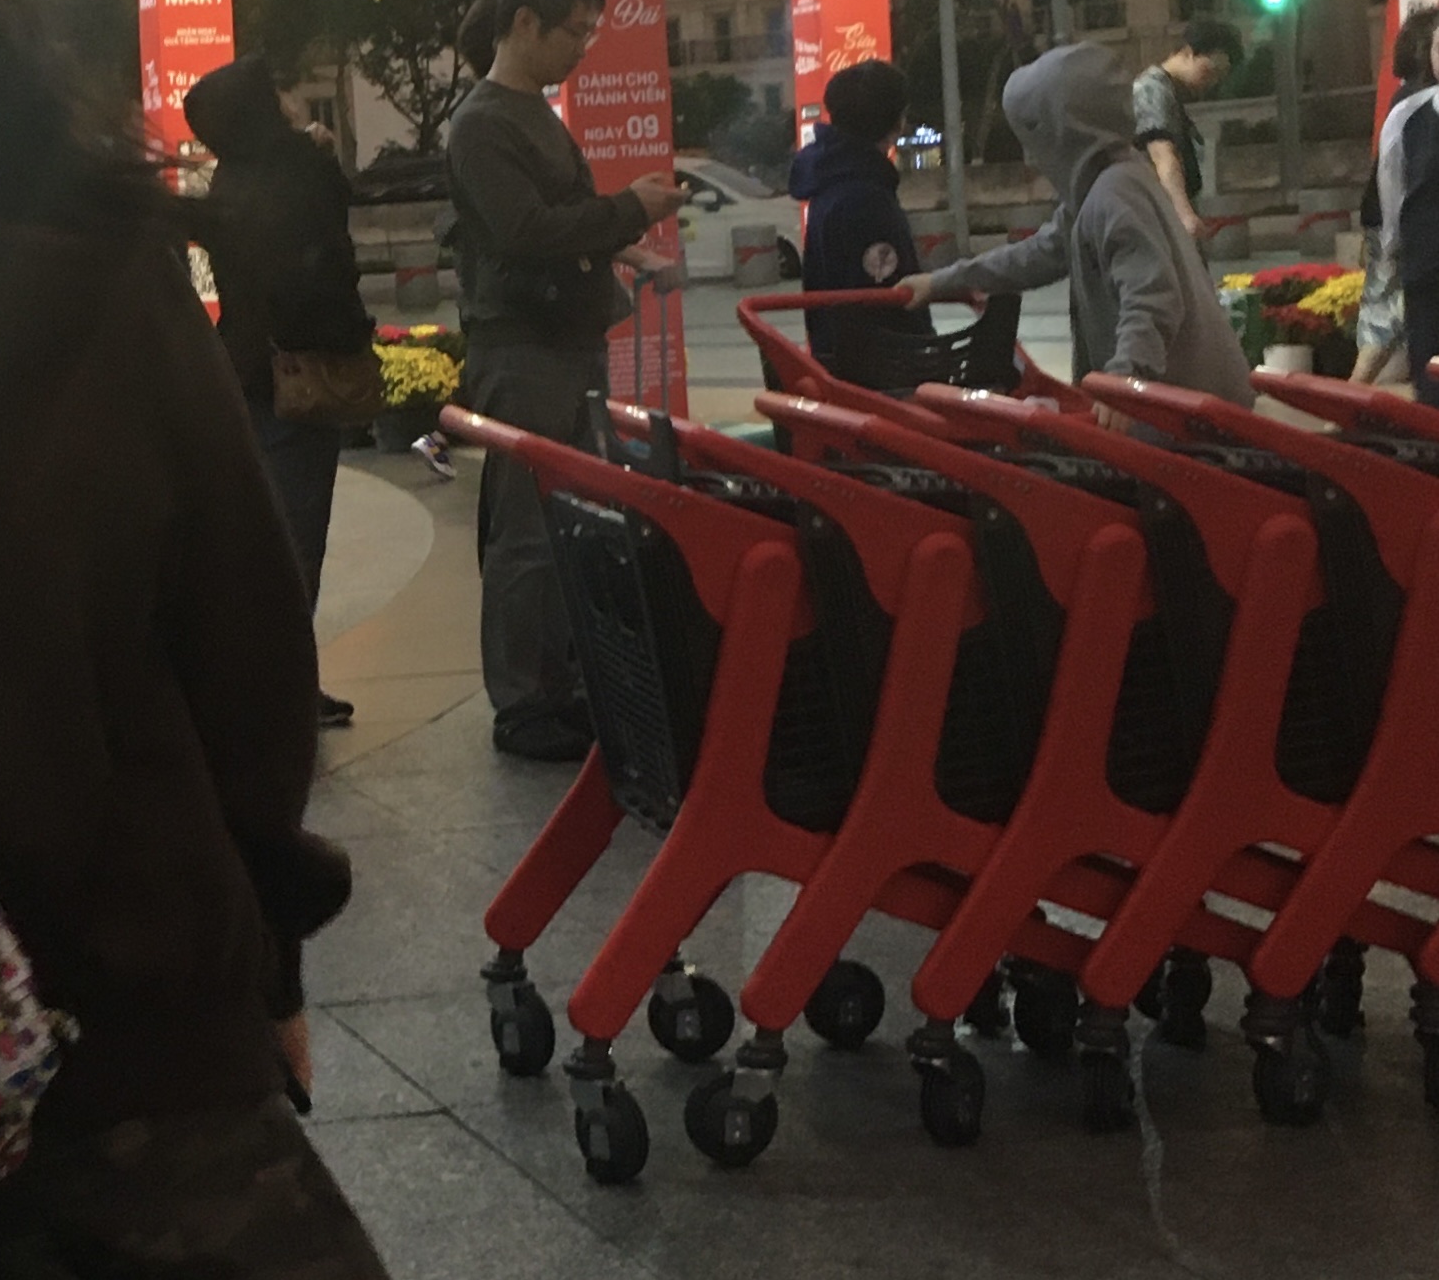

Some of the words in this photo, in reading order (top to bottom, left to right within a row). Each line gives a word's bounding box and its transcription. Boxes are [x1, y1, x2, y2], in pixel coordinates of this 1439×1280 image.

[578, 71, 622, 89] DÀNH
[625, 71, 659, 87] CHO
[574, 88, 627, 107] THÀNH
[629, 84, 666, 103] VIÊN
[626, 114, 660, 140] 09
